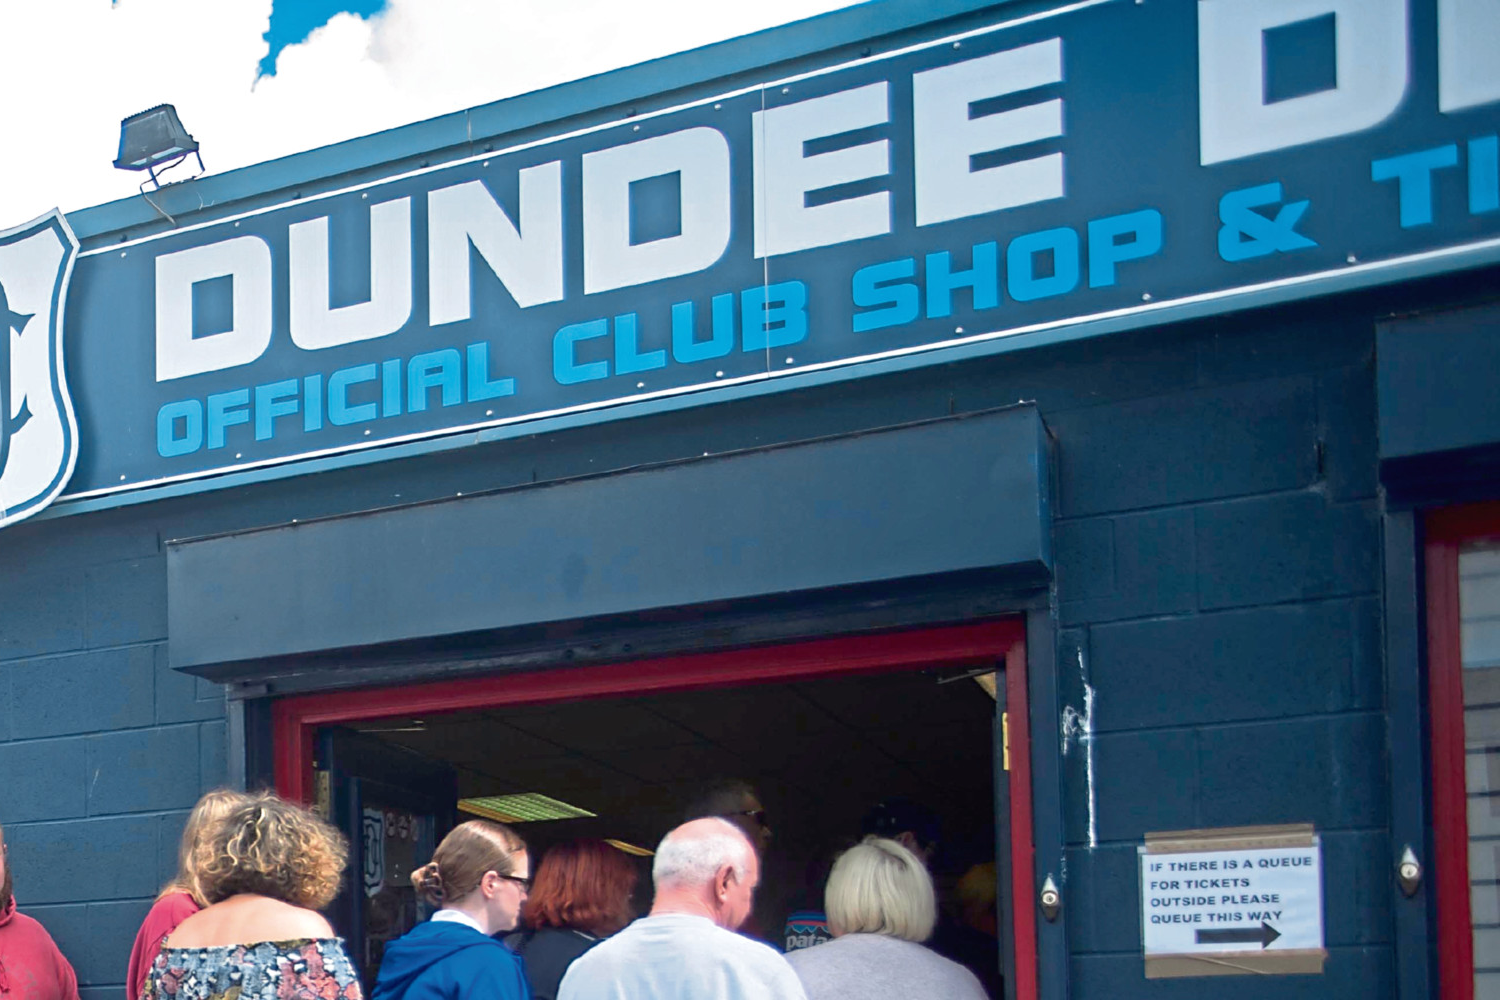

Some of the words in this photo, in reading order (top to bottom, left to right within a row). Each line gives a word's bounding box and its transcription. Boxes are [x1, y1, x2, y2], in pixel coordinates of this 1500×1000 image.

[156, 37, 1064, 382] DUNDEE
[1199, 0, 1500, 166] D
[156, 342, 516, 458] OFFICIAL
[553, 279, 810, 386] CLUB
[852, 208, 1164, 333] SHOP
[1218, 182, 1319, 262] &
[1150, 862, 1163, 872] IF
[1168, 860, 1218, 872] THERE
[1223, 859, 1238, 869] IS
[1243, 859, 1253, 869] A
[1258, 856, 1312, 868] QUEUE
[1150, 880, 1180, 890] FOR
[1184, 878, 1250, 889] TICKETS
[1150, 896, 1216, 908] OUTSIDE
[1221, 893, 1280, 904] PLEASE
[1150, 913, 1202, 924] QUEUE
[1206, 912, 1242, 922] THIS
[1247, 910, 1282, 921] WAY
